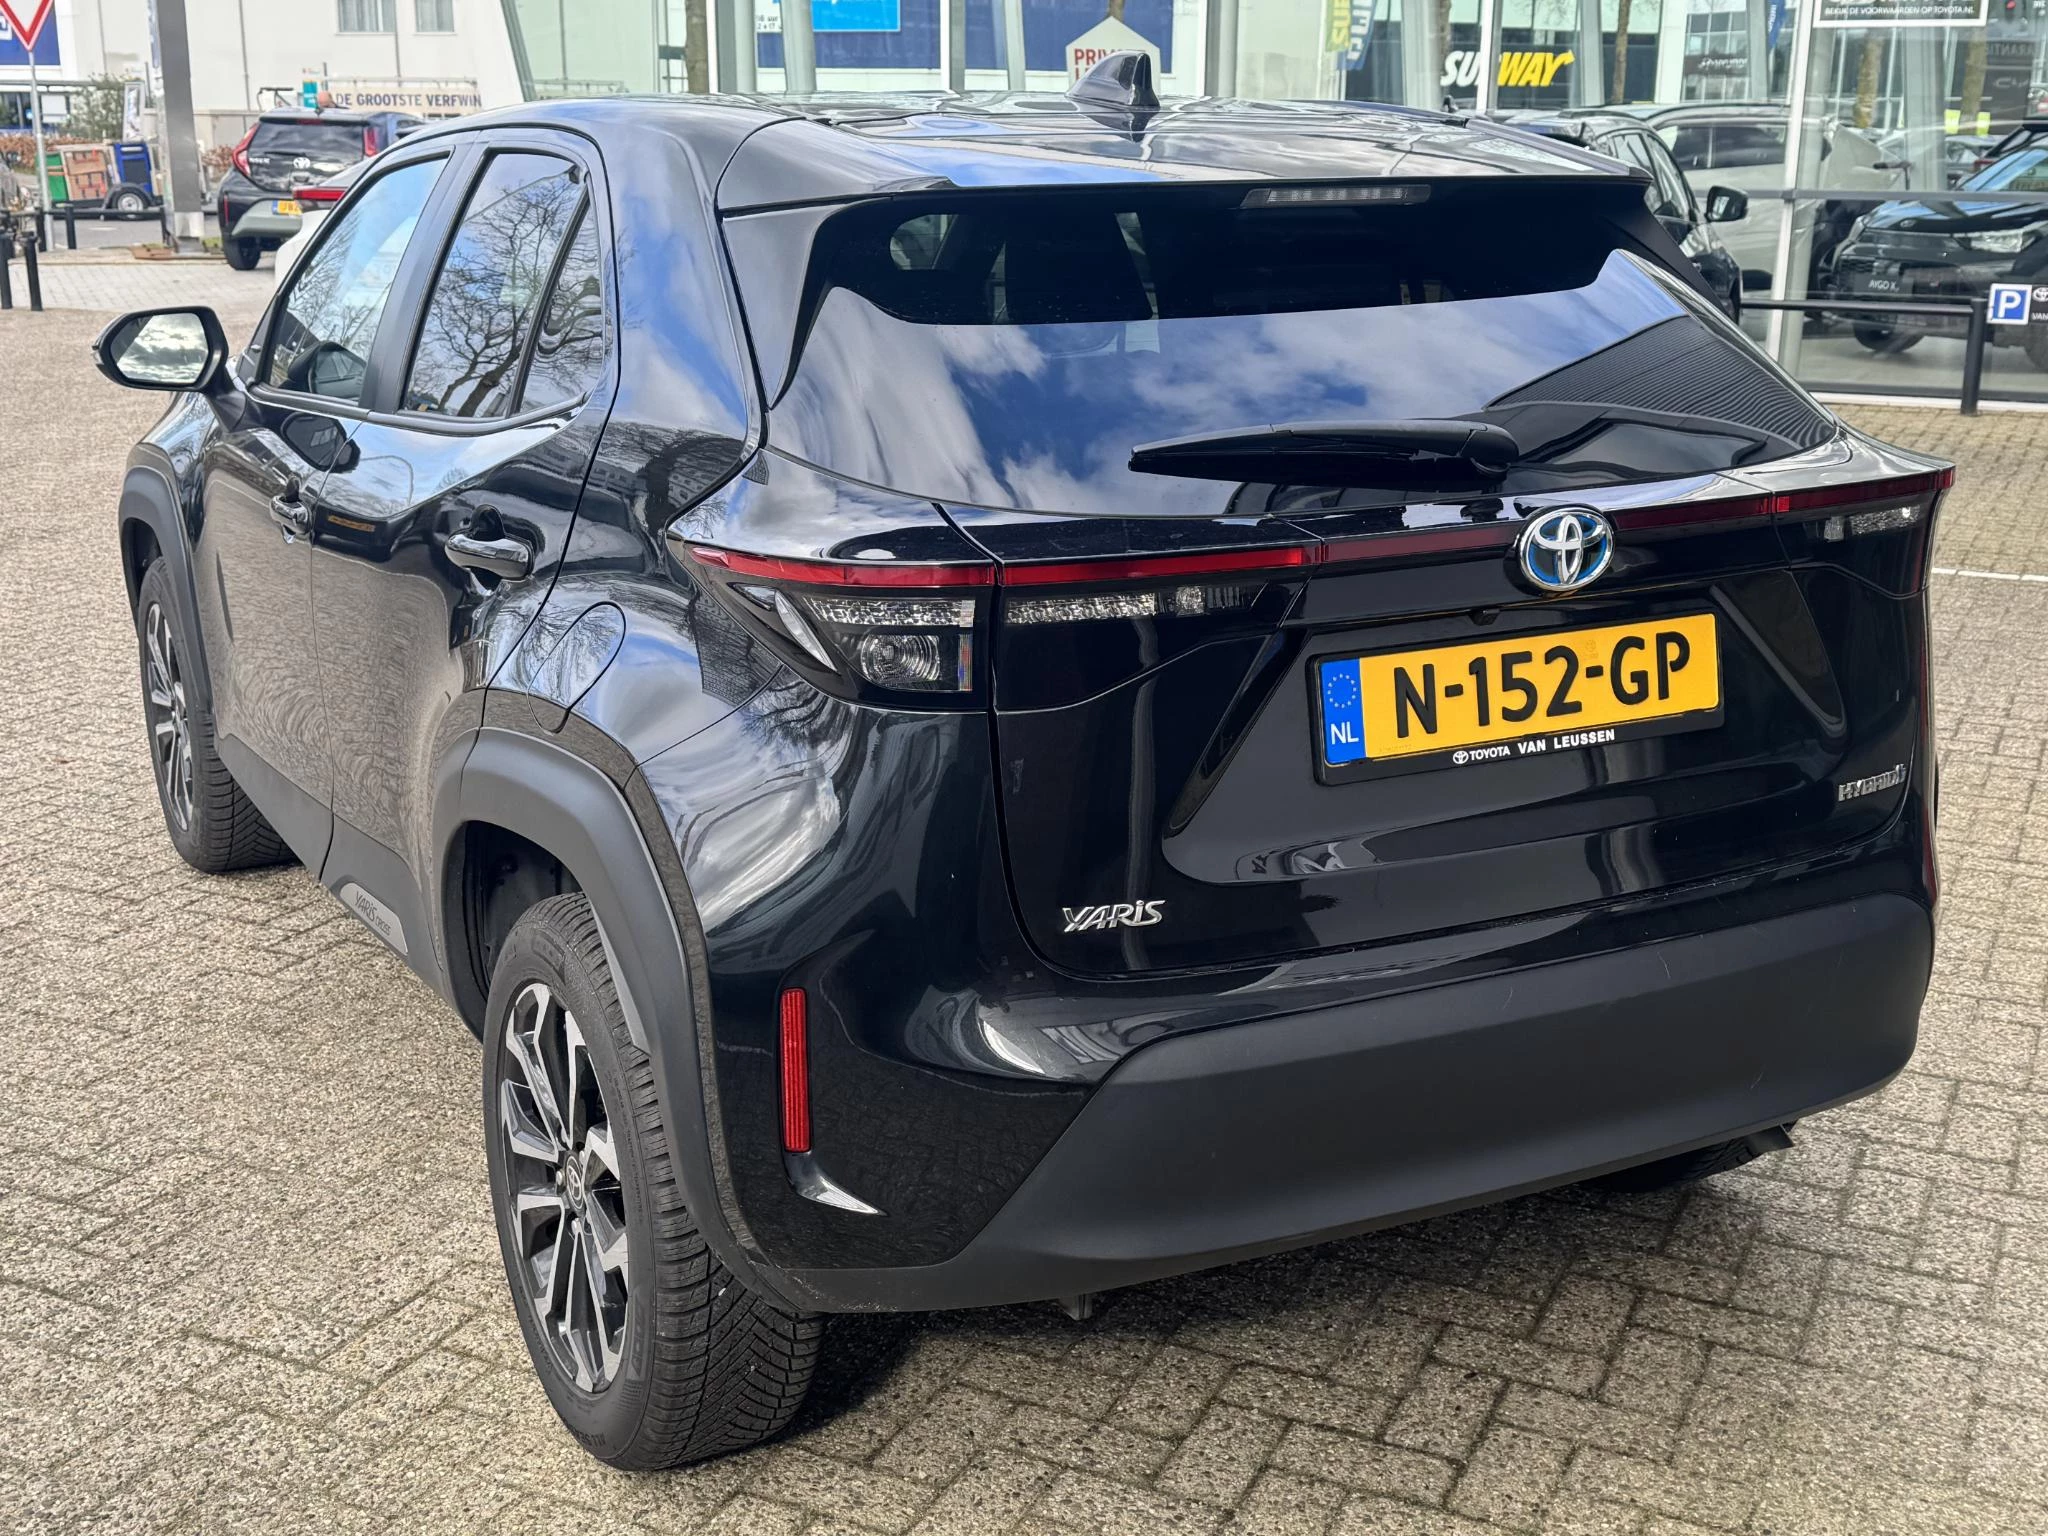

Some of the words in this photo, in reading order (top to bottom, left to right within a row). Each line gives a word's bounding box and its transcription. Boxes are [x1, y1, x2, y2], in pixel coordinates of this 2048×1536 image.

[1440, 50, 1576, 88] SUWAY
[336, 93, 352, 106] DE
[356, 93, 422, 107] GROOTSTE
[1393, 630, 1690, 738] N-152-GP
[1330, 721, 1359, 745] NL
[1469, 746, 1511, 761] TOYOTA
[1517, 739, 1546, 754] VAN
[1554, 729, 1615, 750] LEUSSEN
[1838, 763, 1906, 802] HYBRID
